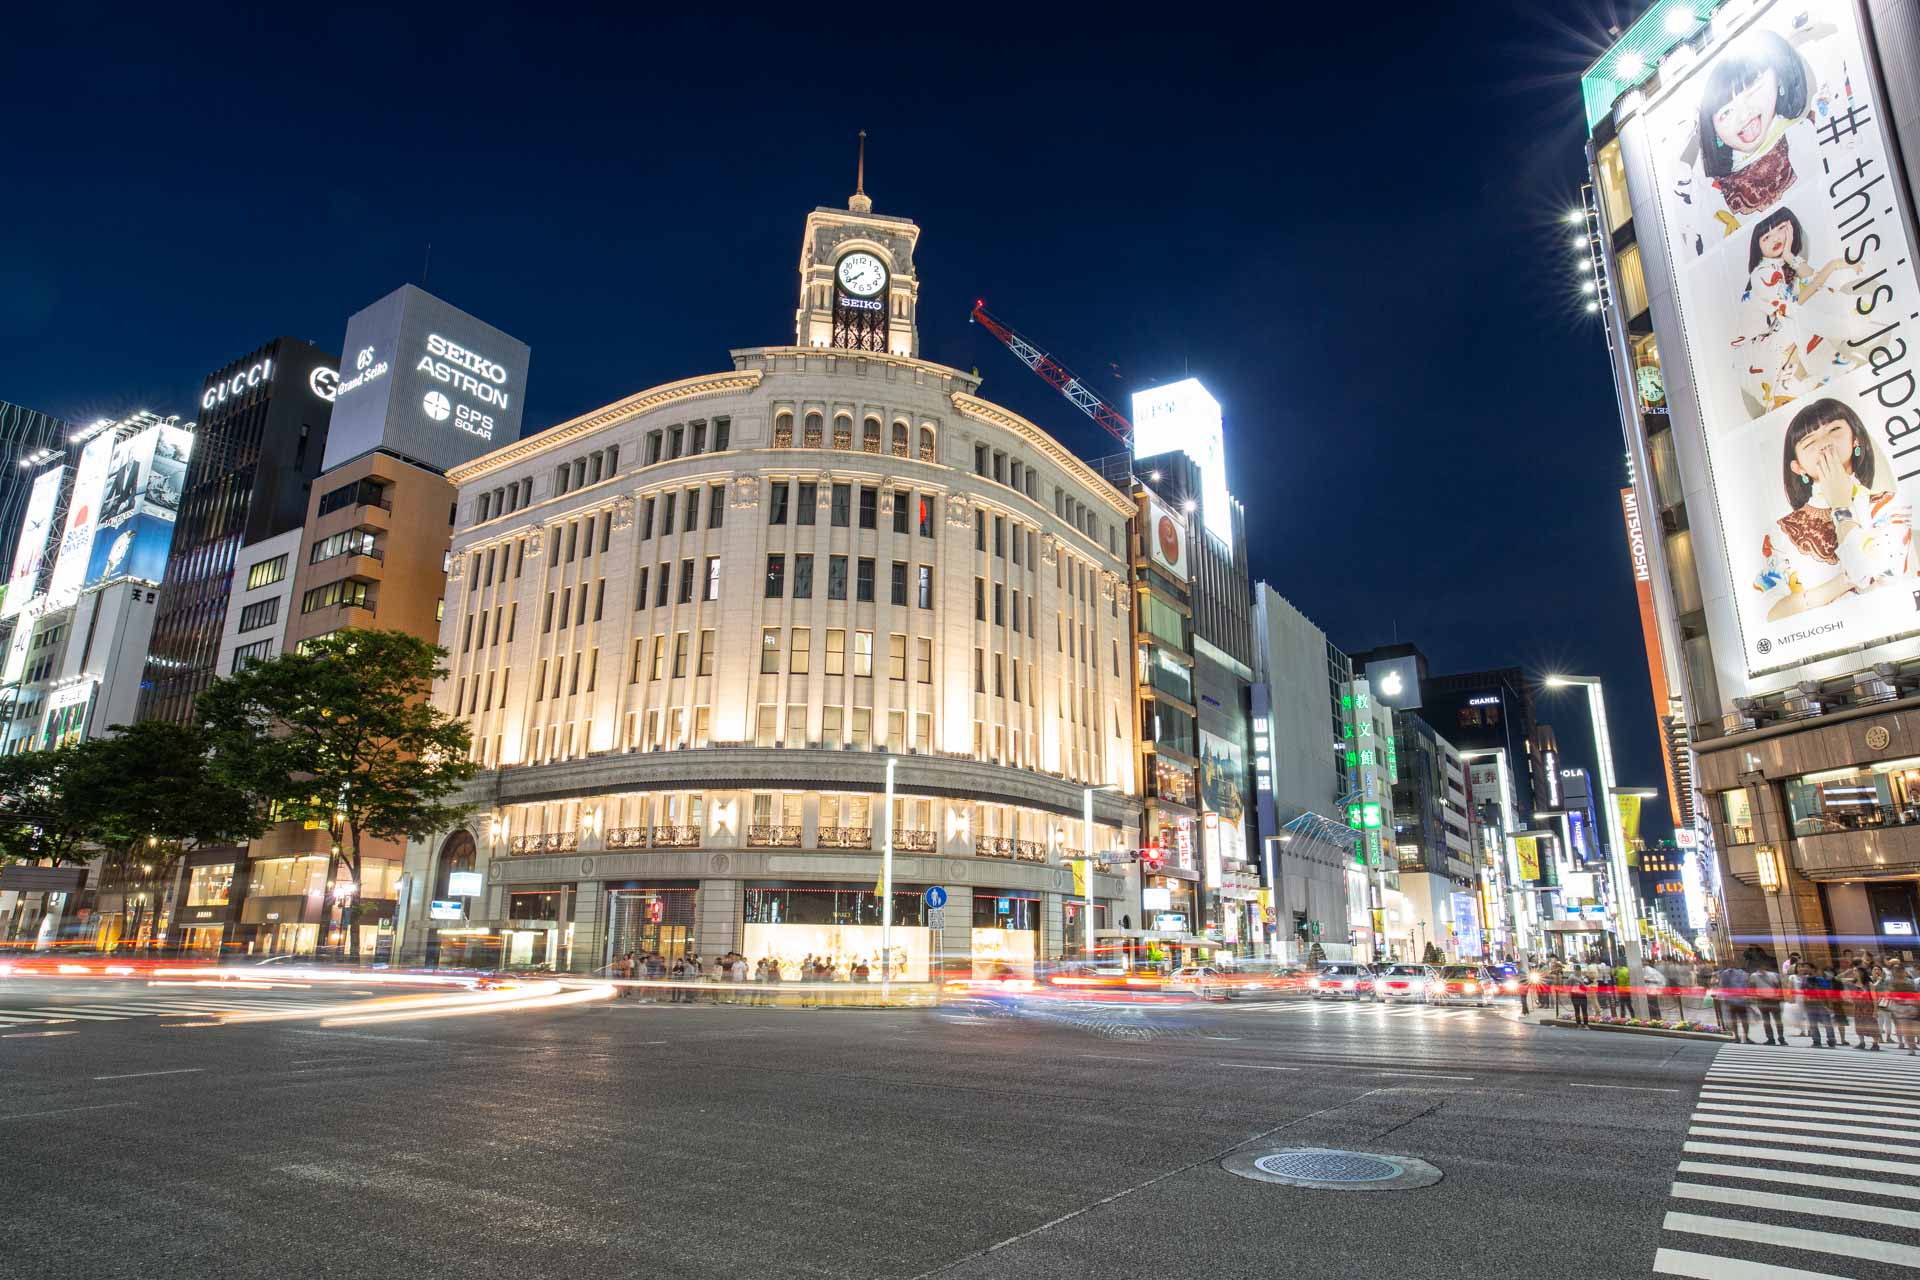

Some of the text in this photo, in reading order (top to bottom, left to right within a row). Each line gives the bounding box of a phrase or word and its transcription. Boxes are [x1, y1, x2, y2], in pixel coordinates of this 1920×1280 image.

[841, 298, 882, 310] SEIKO
[357, 345, 375, 370] GS
[426, 333, 507, 385] SEIKO
[202, 358, 273, 410] GUCCI
[337, 361, 388, 396] Grand Seiko
[416, 355, 509, 410] ASTRON
[454, 418, 493, 441] SOLAR
[455, 403, 494, 430] GPS
[1621, 493, 1650, 583] MITSUKOSHI
[1777, 620, 1845, 647] MITSUKOSHI
[1469, 696, 1500, 706] CHANEL
[1354, 693, 1374, 766] 教文館
[1560, 769, 1584, 778] OLA
